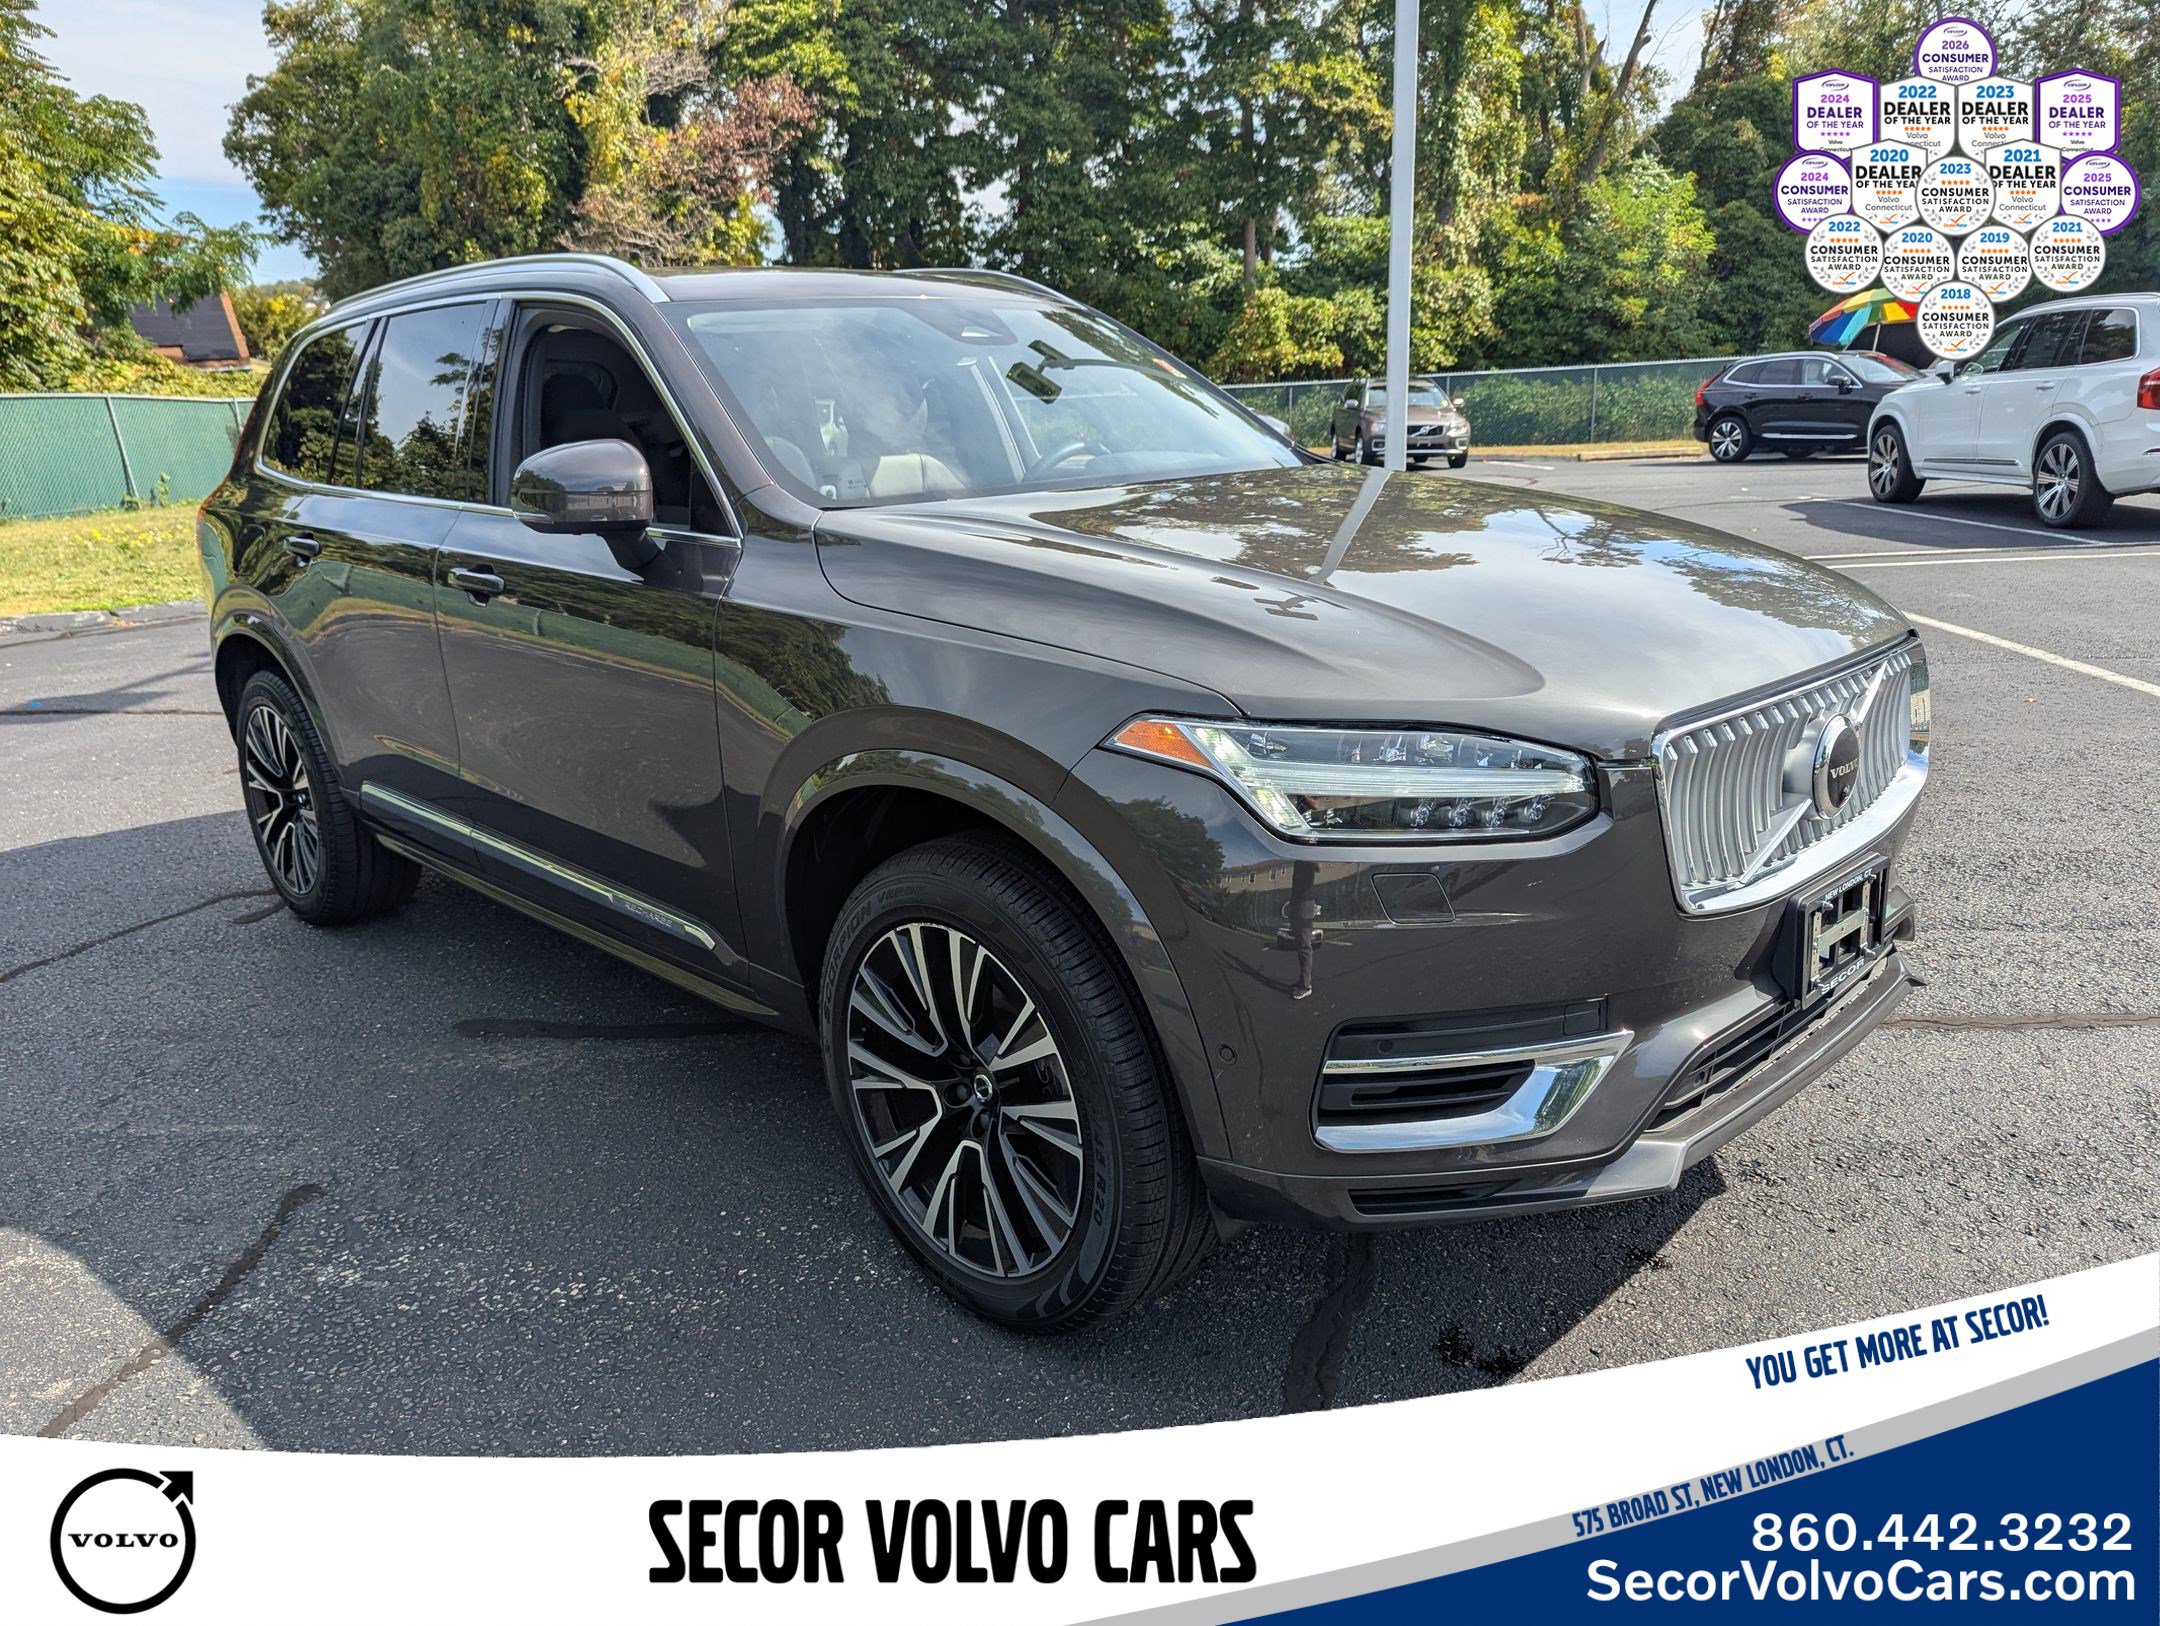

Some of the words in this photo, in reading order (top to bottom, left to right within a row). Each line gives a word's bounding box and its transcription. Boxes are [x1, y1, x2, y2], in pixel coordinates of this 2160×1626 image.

[1830, 757, 1858, 779] VOLV
[1825, 887, 1839, 900] NEW
[1821, 959, 1865, 995] SECOR
